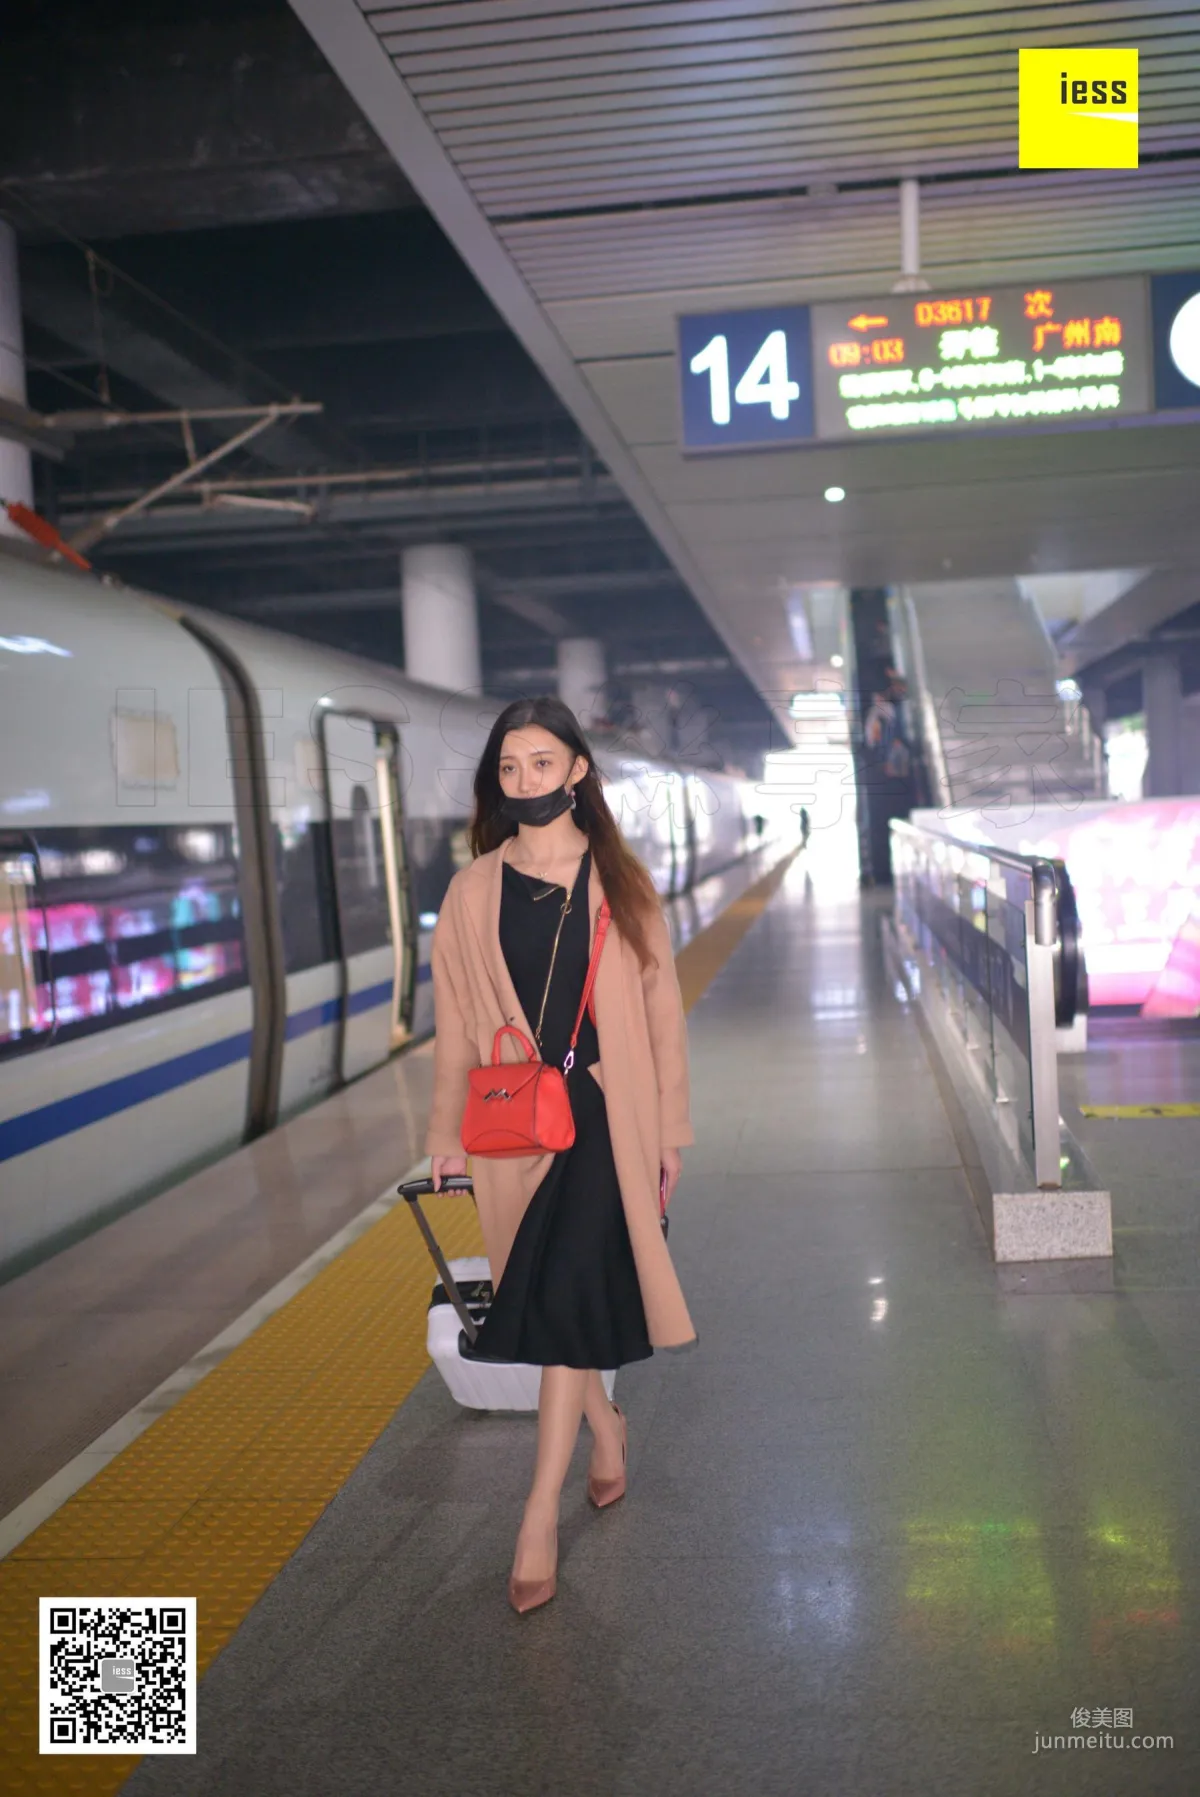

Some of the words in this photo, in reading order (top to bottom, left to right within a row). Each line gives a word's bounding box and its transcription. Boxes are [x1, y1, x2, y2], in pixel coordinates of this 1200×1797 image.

[1024, 289, 1054, 319] 次
[1032, 315, 1122, 352] 广州南
[690, 330, 800, 425] 14
